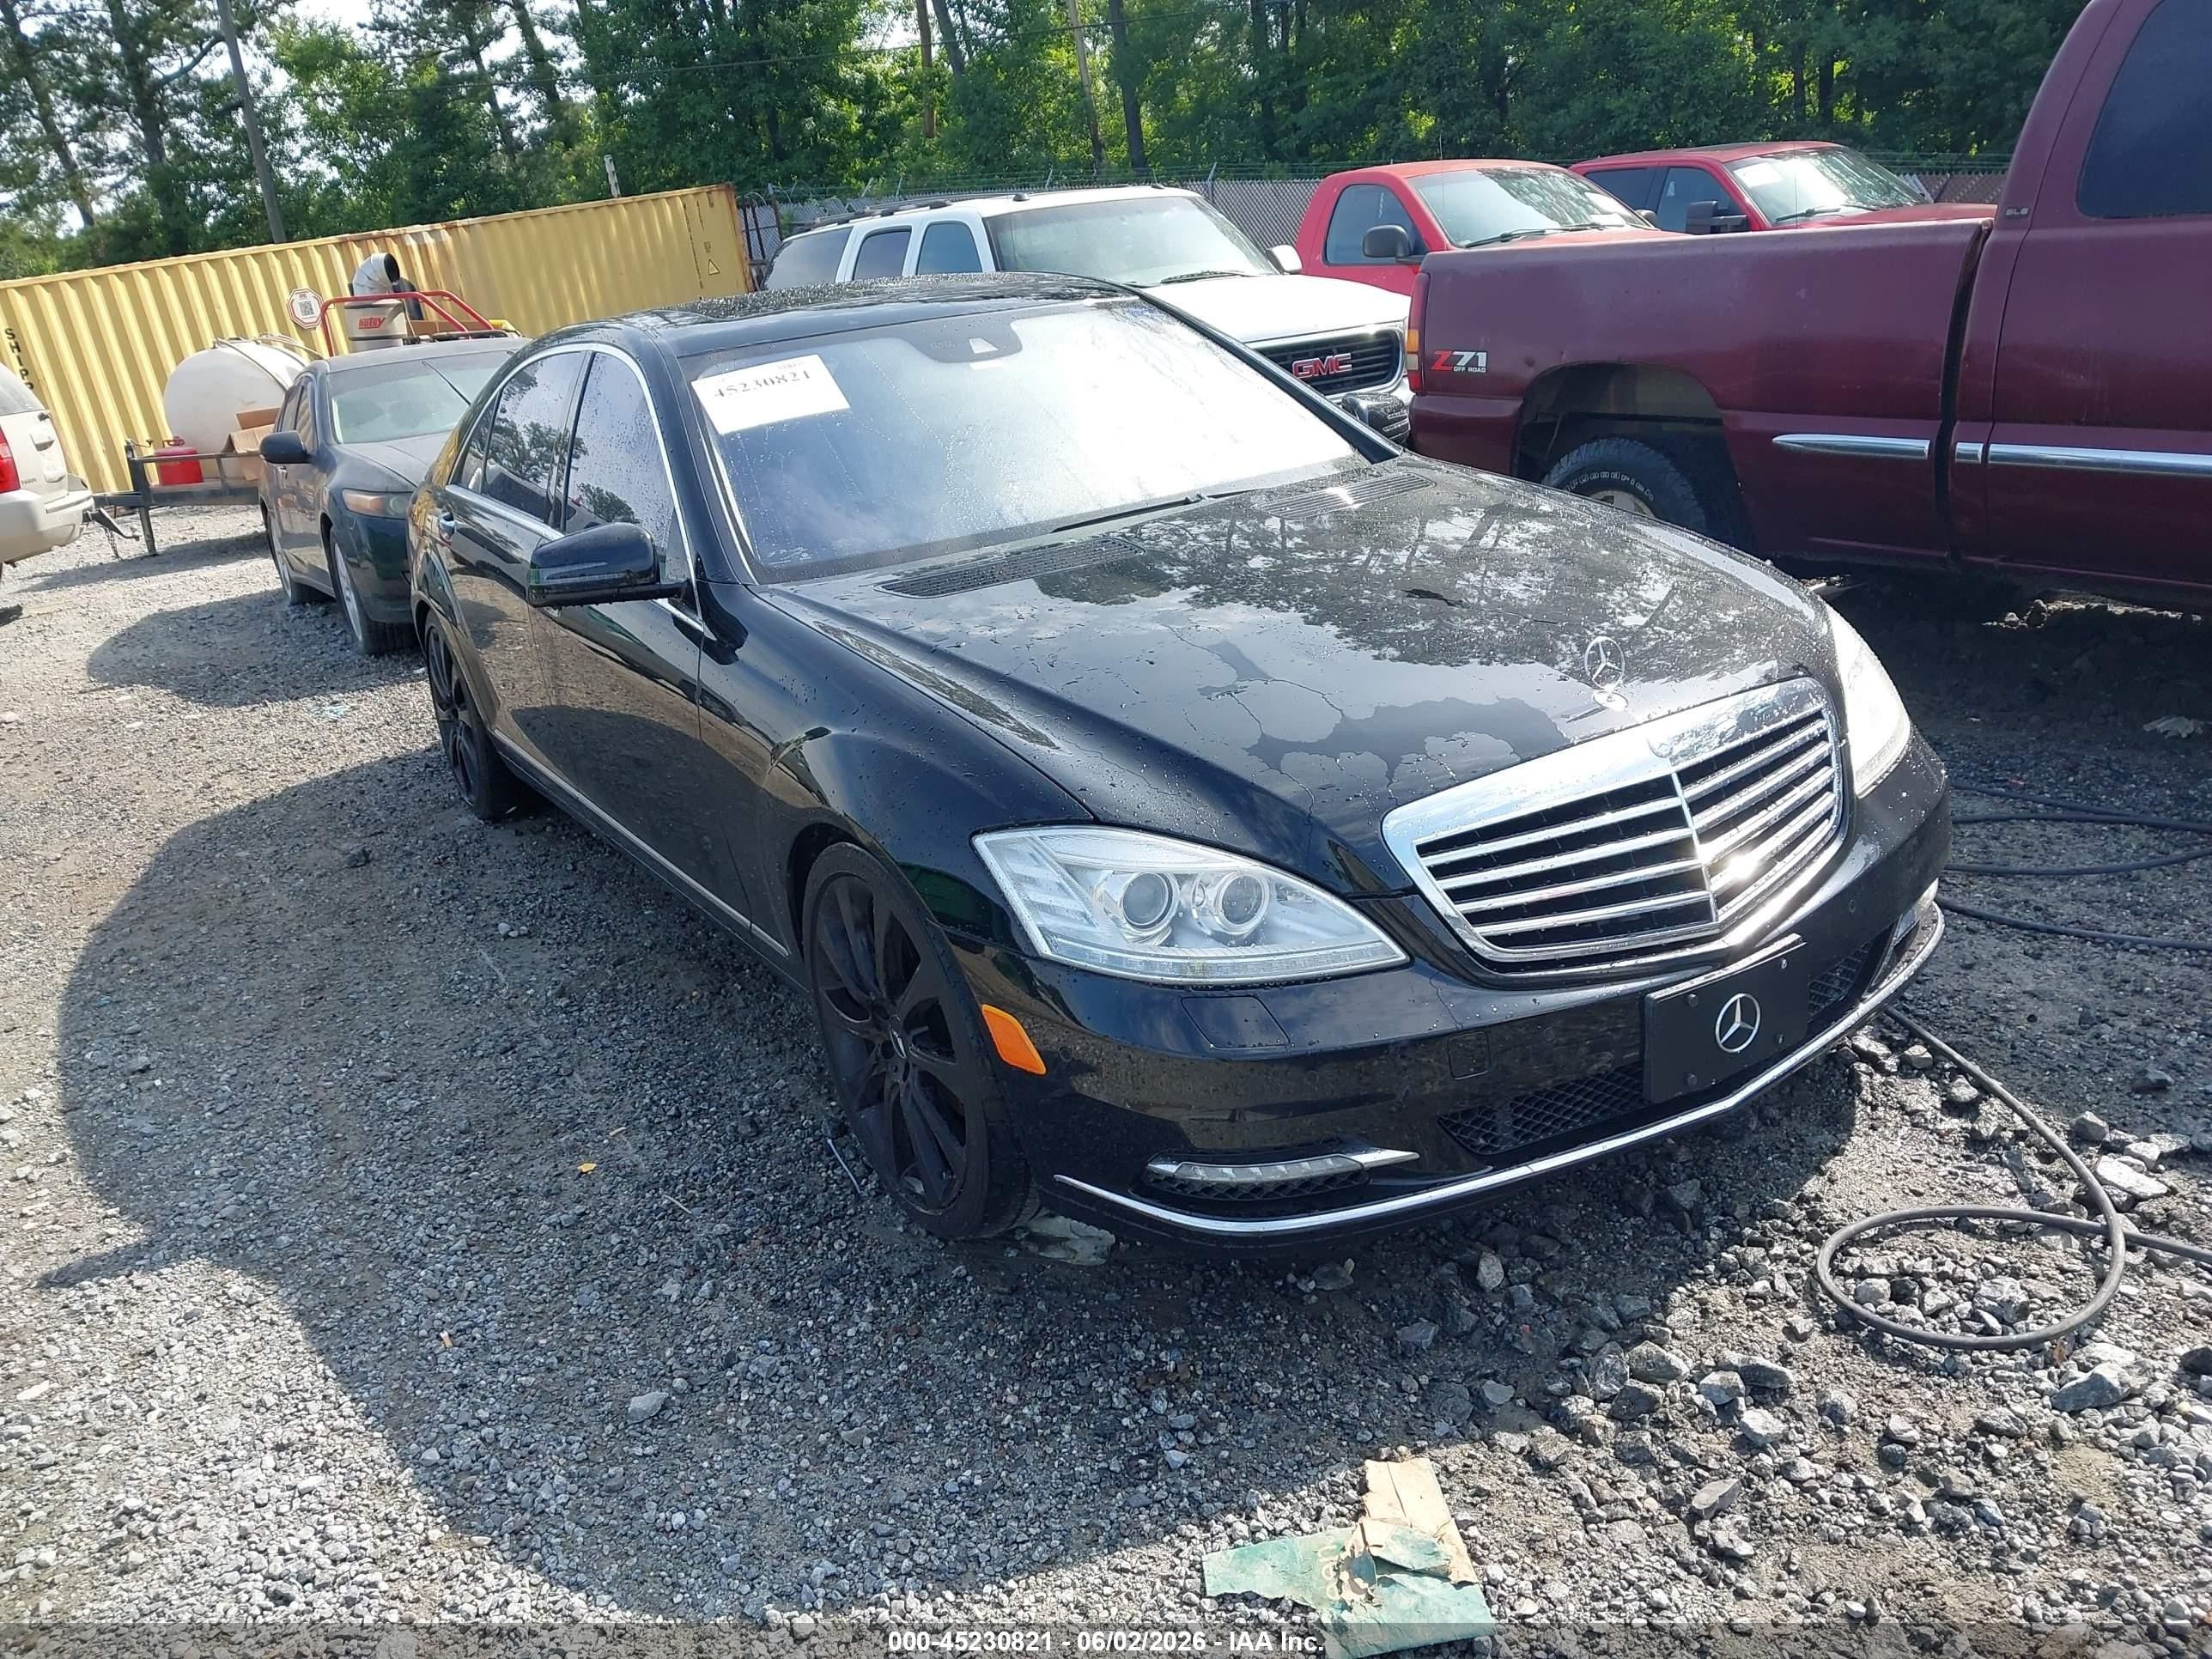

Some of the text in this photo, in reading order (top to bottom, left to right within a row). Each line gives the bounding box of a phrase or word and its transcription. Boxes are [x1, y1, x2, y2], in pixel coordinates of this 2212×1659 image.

[1291, 352, 1352, 380] GMC
[1431, 350, 1487, 372] Z71
[714, 370, 811, 398] 45230821
